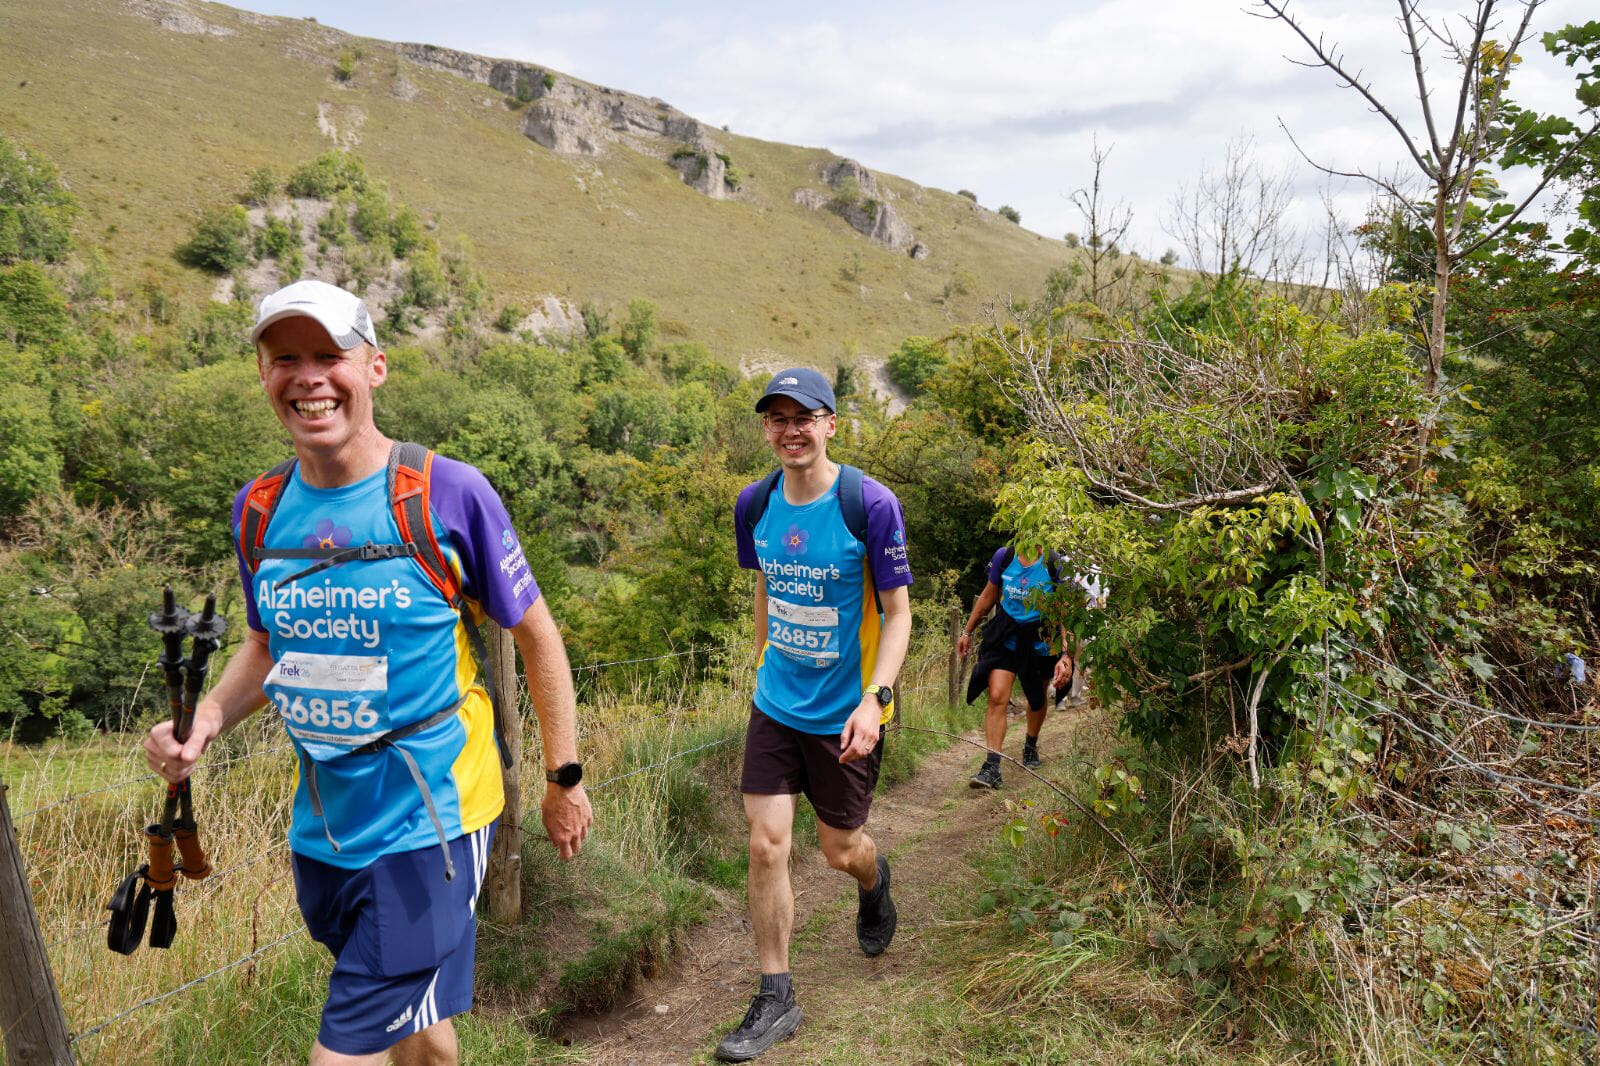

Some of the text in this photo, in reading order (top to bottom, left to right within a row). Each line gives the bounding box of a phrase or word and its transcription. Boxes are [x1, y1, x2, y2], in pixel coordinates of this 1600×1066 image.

[257, 578, 412, 610] Alzheimer's
[766, 575, 824, 602] Society
[274, 610, 381, 649] Society
[771, 621, 832, 649] 26857
[274, 691, 379, 730] 26856
